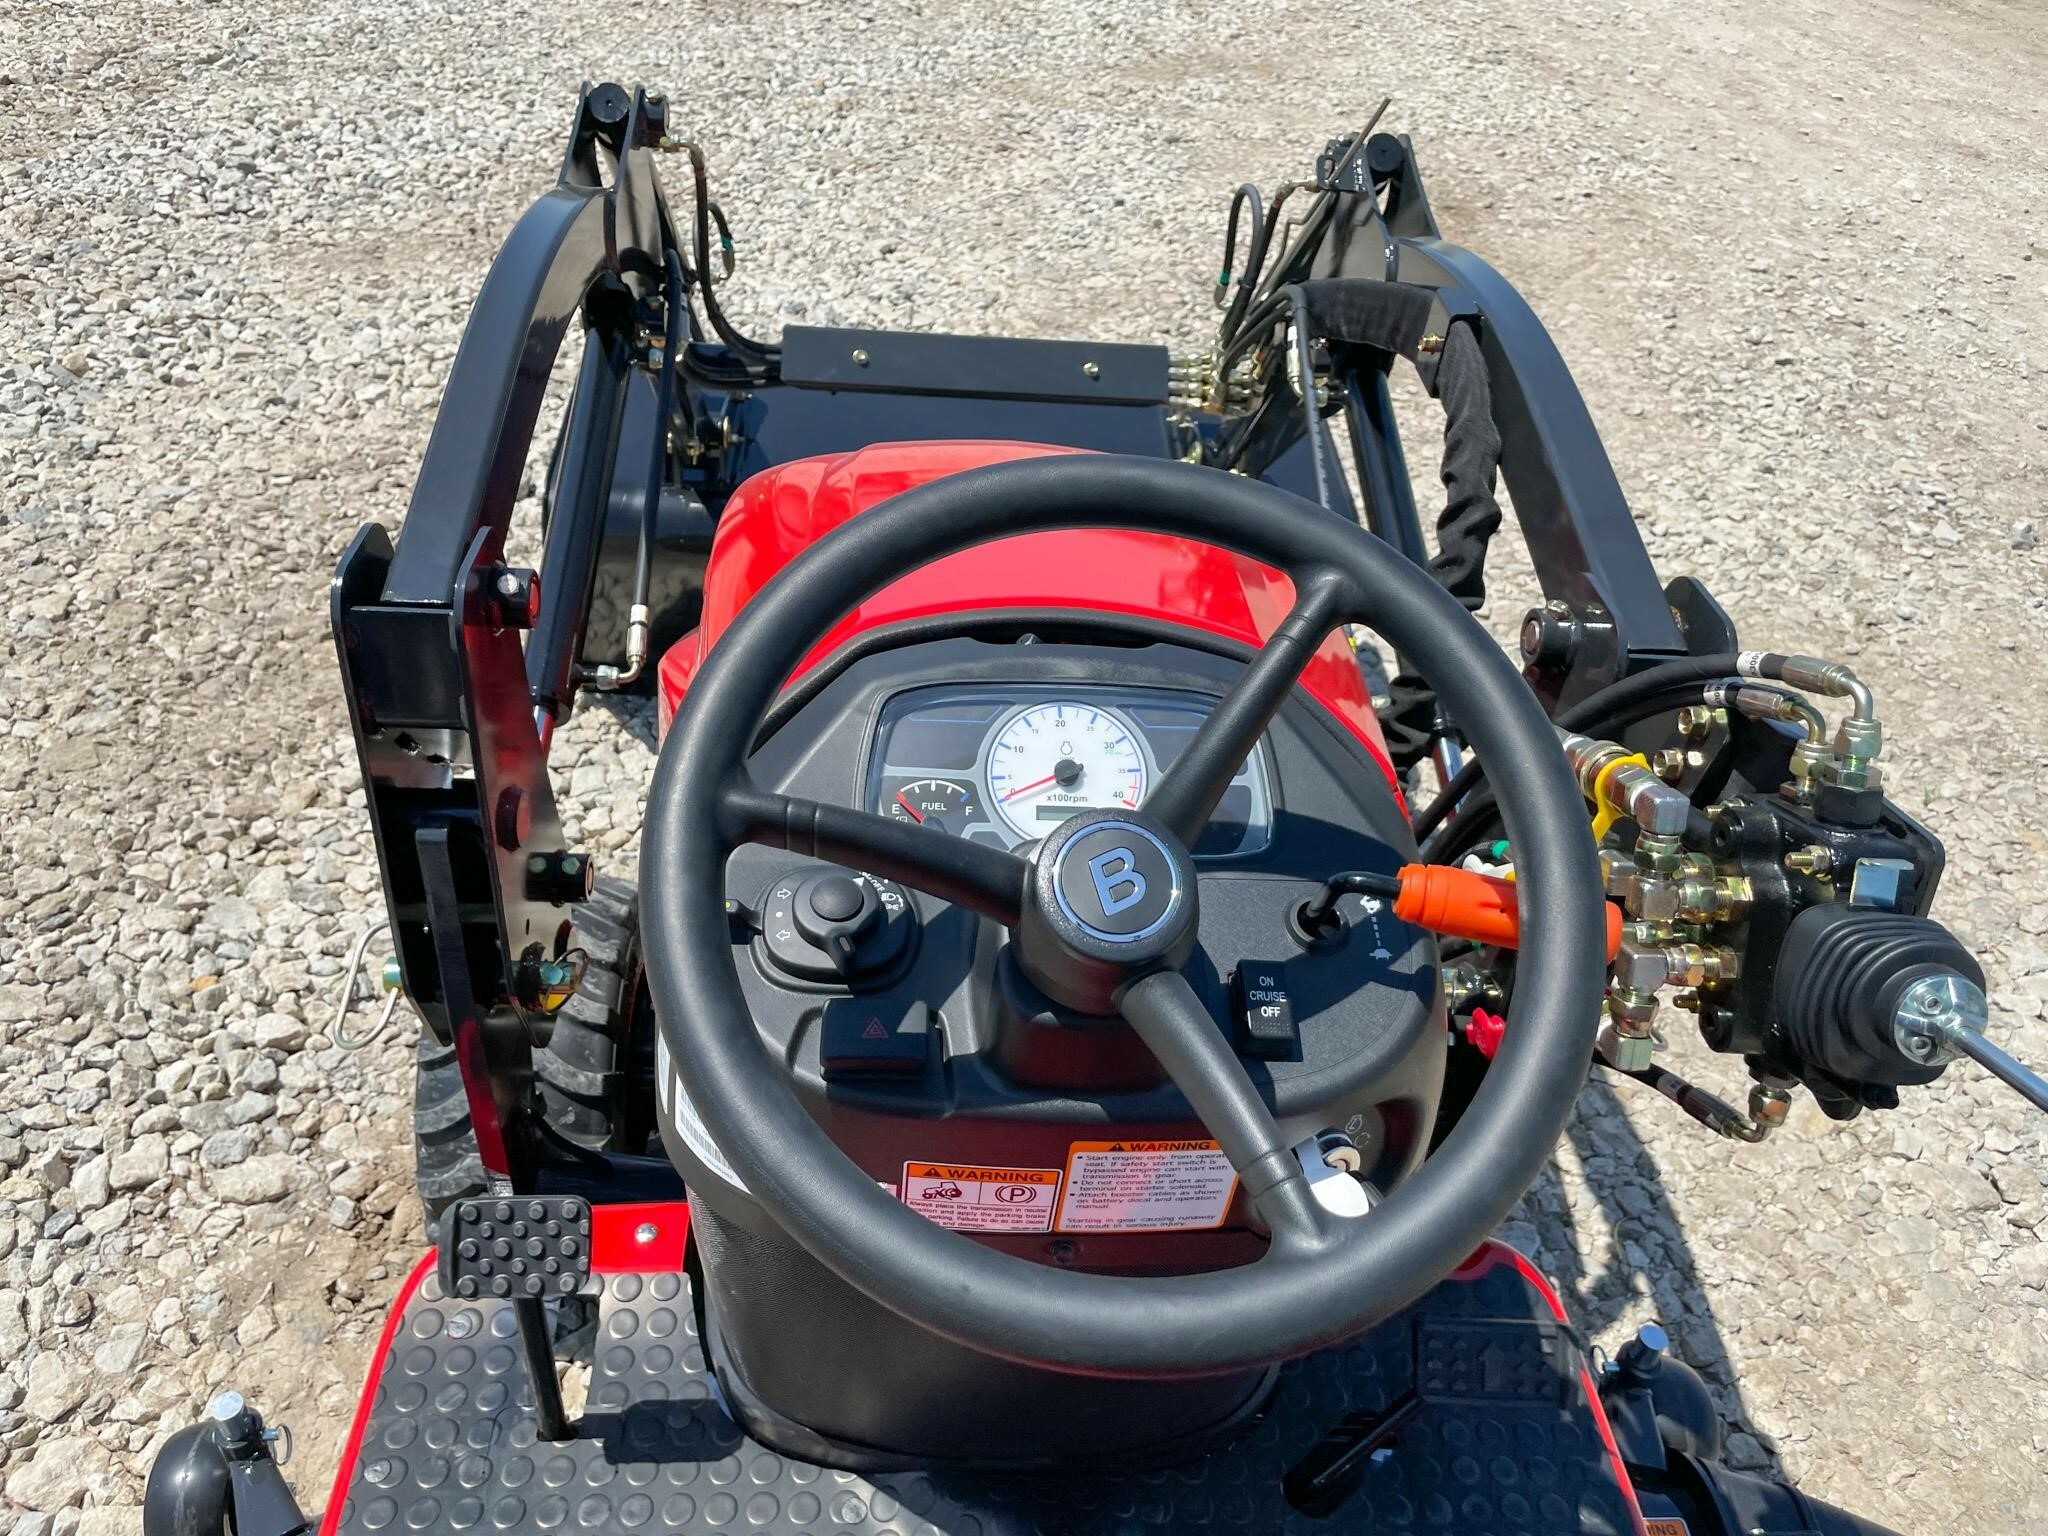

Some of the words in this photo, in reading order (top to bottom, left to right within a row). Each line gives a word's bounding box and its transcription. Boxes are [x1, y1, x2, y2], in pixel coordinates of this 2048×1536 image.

[1055, 719, 1066, 728] 20
[1014, 745, 1024, 753] 10
[1104, 741, 1115, 750] 30
[1046, 793, 1088, 803] x100rpm
[1112, 790, 1124, 799] 40
[892, 803, 900, 814] E
[921, 802, 947, 811] FUEL
[965, 806, 974, 816] F
[1087, 846, 1147, 917] B
[1259, 975, 1275, 987] ON
[1249, 990, 1288, 1002] CRUISE
[1260, 1005, 1281, 1018] OFF
[1130, 1141, 1210, 1152] WARNING
[1195, 1152, 1225, 1161] operat
[1120, 1160, 1149, 1168] safety
[1177, 1158, 1206, 1166] switch
[947, 1168, 1044, 1183] WARNING
[909, 1200, 933, 1208] Always
[1140, 1215, 1175, 1223] causing
